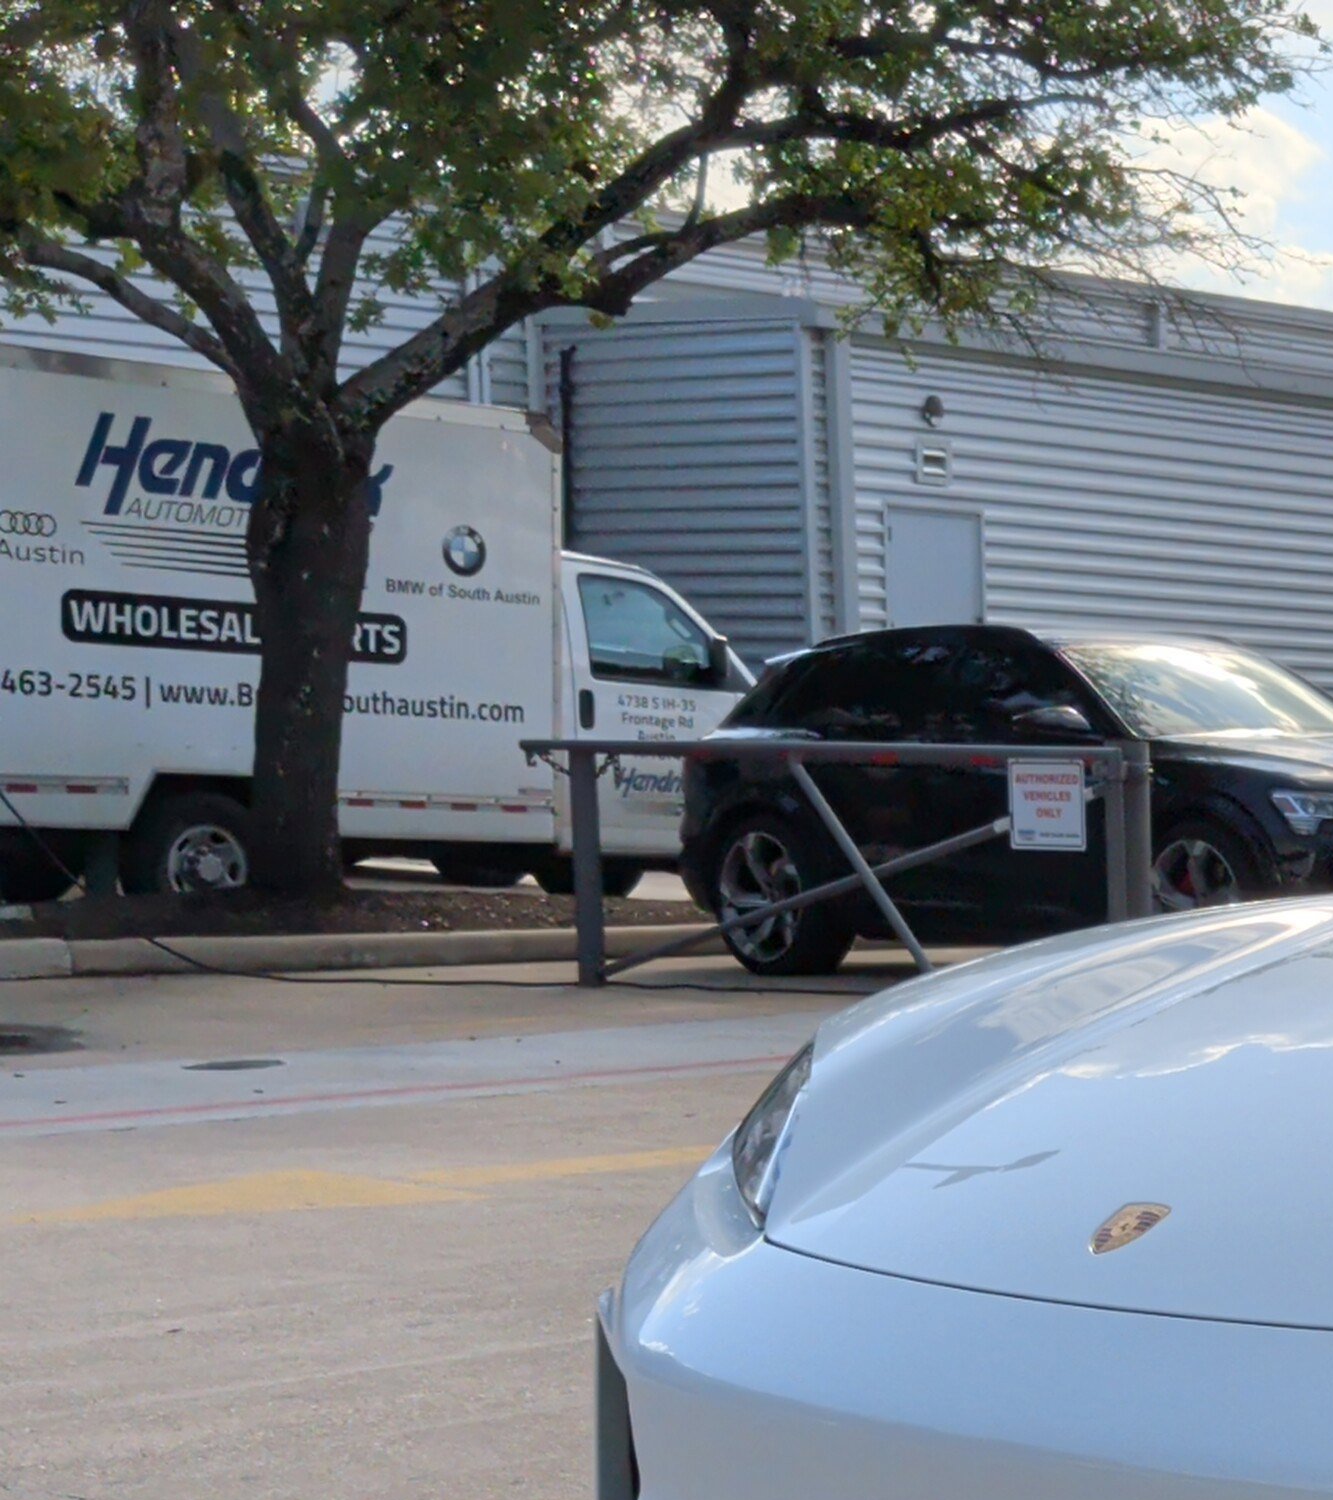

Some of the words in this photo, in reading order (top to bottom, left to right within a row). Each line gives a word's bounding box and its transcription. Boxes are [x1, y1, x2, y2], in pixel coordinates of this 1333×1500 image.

[126, 498, 250, 527] AUTOMOT
[0, 539, 84, 566] Austin
[386, 579, 424, 595] BMW
[428, 583, 444, 598] of
[448, 584, 490, 601] South
[494, 590, 541, 606] Austin
[69, 600, 262, 644] WHOLESAL
[1, 669, 136, 701] 463-2545
[621, 712, 676, 731] Frontage
[678, 716, 694, 729] Rd
[1015, 774, 1079, 785] AUTHORIZED
[1024, 791, 1071, 802] VEHICLES
[1036, 808, 1062, 819] ONLY
